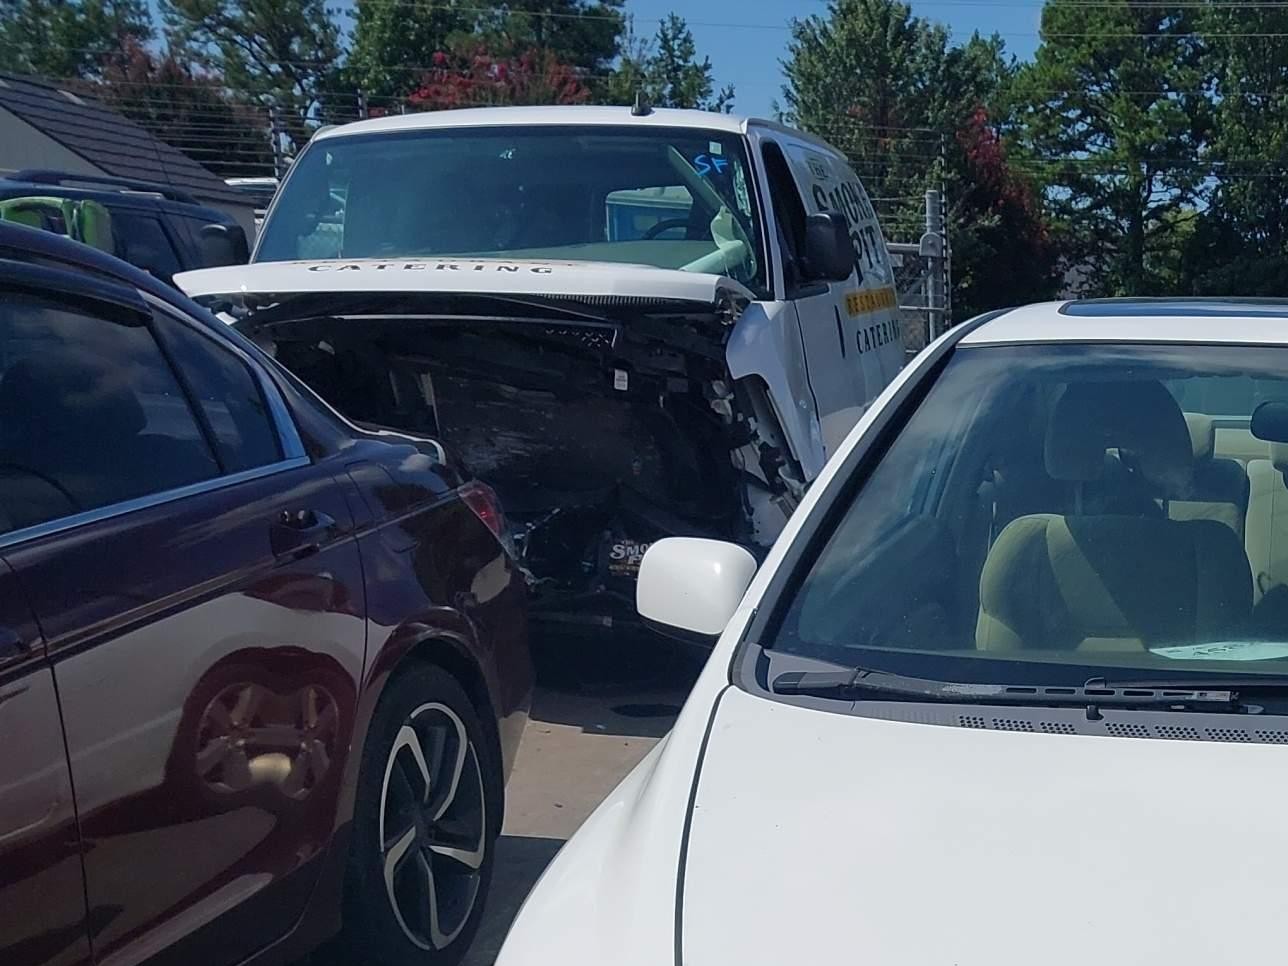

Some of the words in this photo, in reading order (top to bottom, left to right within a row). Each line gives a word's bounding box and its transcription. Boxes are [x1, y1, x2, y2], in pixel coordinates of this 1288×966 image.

[693, 154, 729, 177] SF
[307, 263, 553, 274] CATERING
[850, 226, 881, 287] PIT
[856, 320, 901, 355] CATERIN
